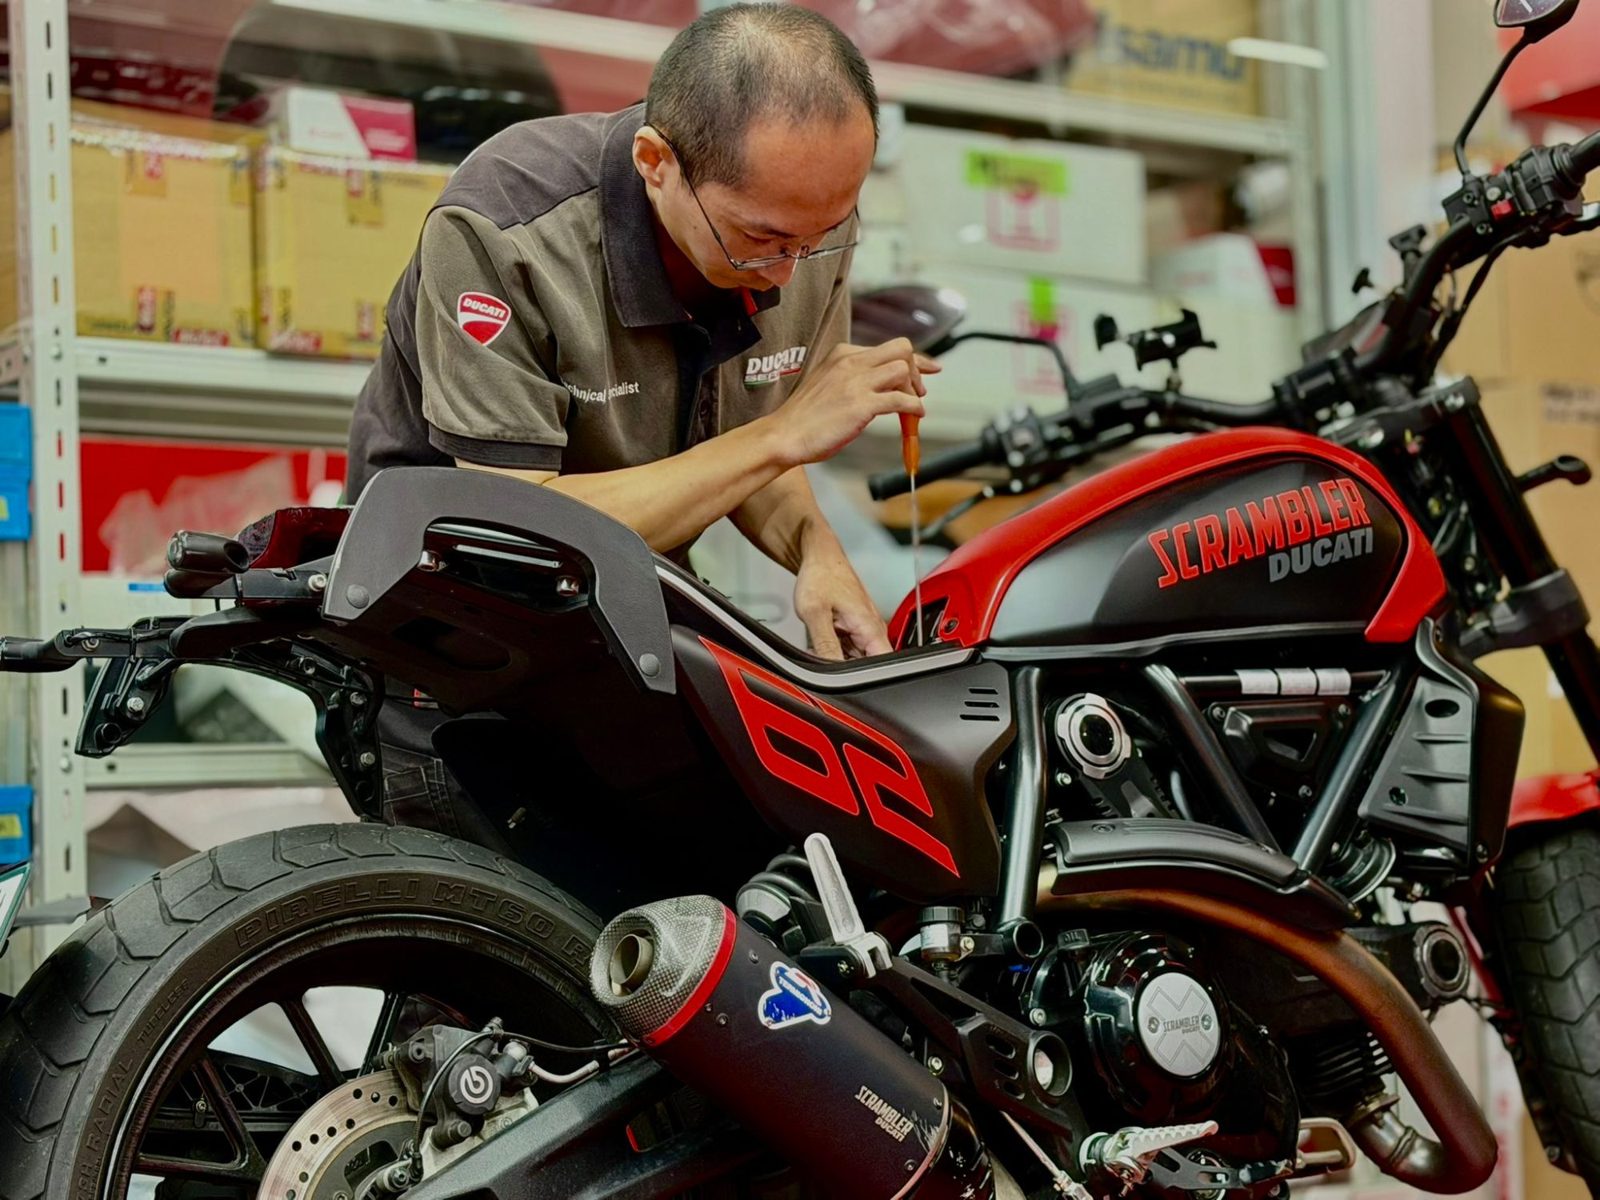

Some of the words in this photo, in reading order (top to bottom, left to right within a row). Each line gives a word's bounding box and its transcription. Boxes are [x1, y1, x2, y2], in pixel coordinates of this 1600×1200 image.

[462, 297, 507, 319] DUCATI
[745, 346, 807, 375] DUCATI
[564, 382, 606, 403] chnical
[1147, 478, 1371, 588] SCRAMBLER
[1269, 527, 1373, 582] DUCATI
[234, 879, 419, 948] PIRELLI
[432, 880, 556, 939] MT60
[1163, 1015, 1200, 1032] SCRAMBLER
[86, 1057, 133, 1152] RADIAL
[854, 1085, 914, 1136] SCRAMBLER
[874, 1116, 905, 1142] DUCATI
